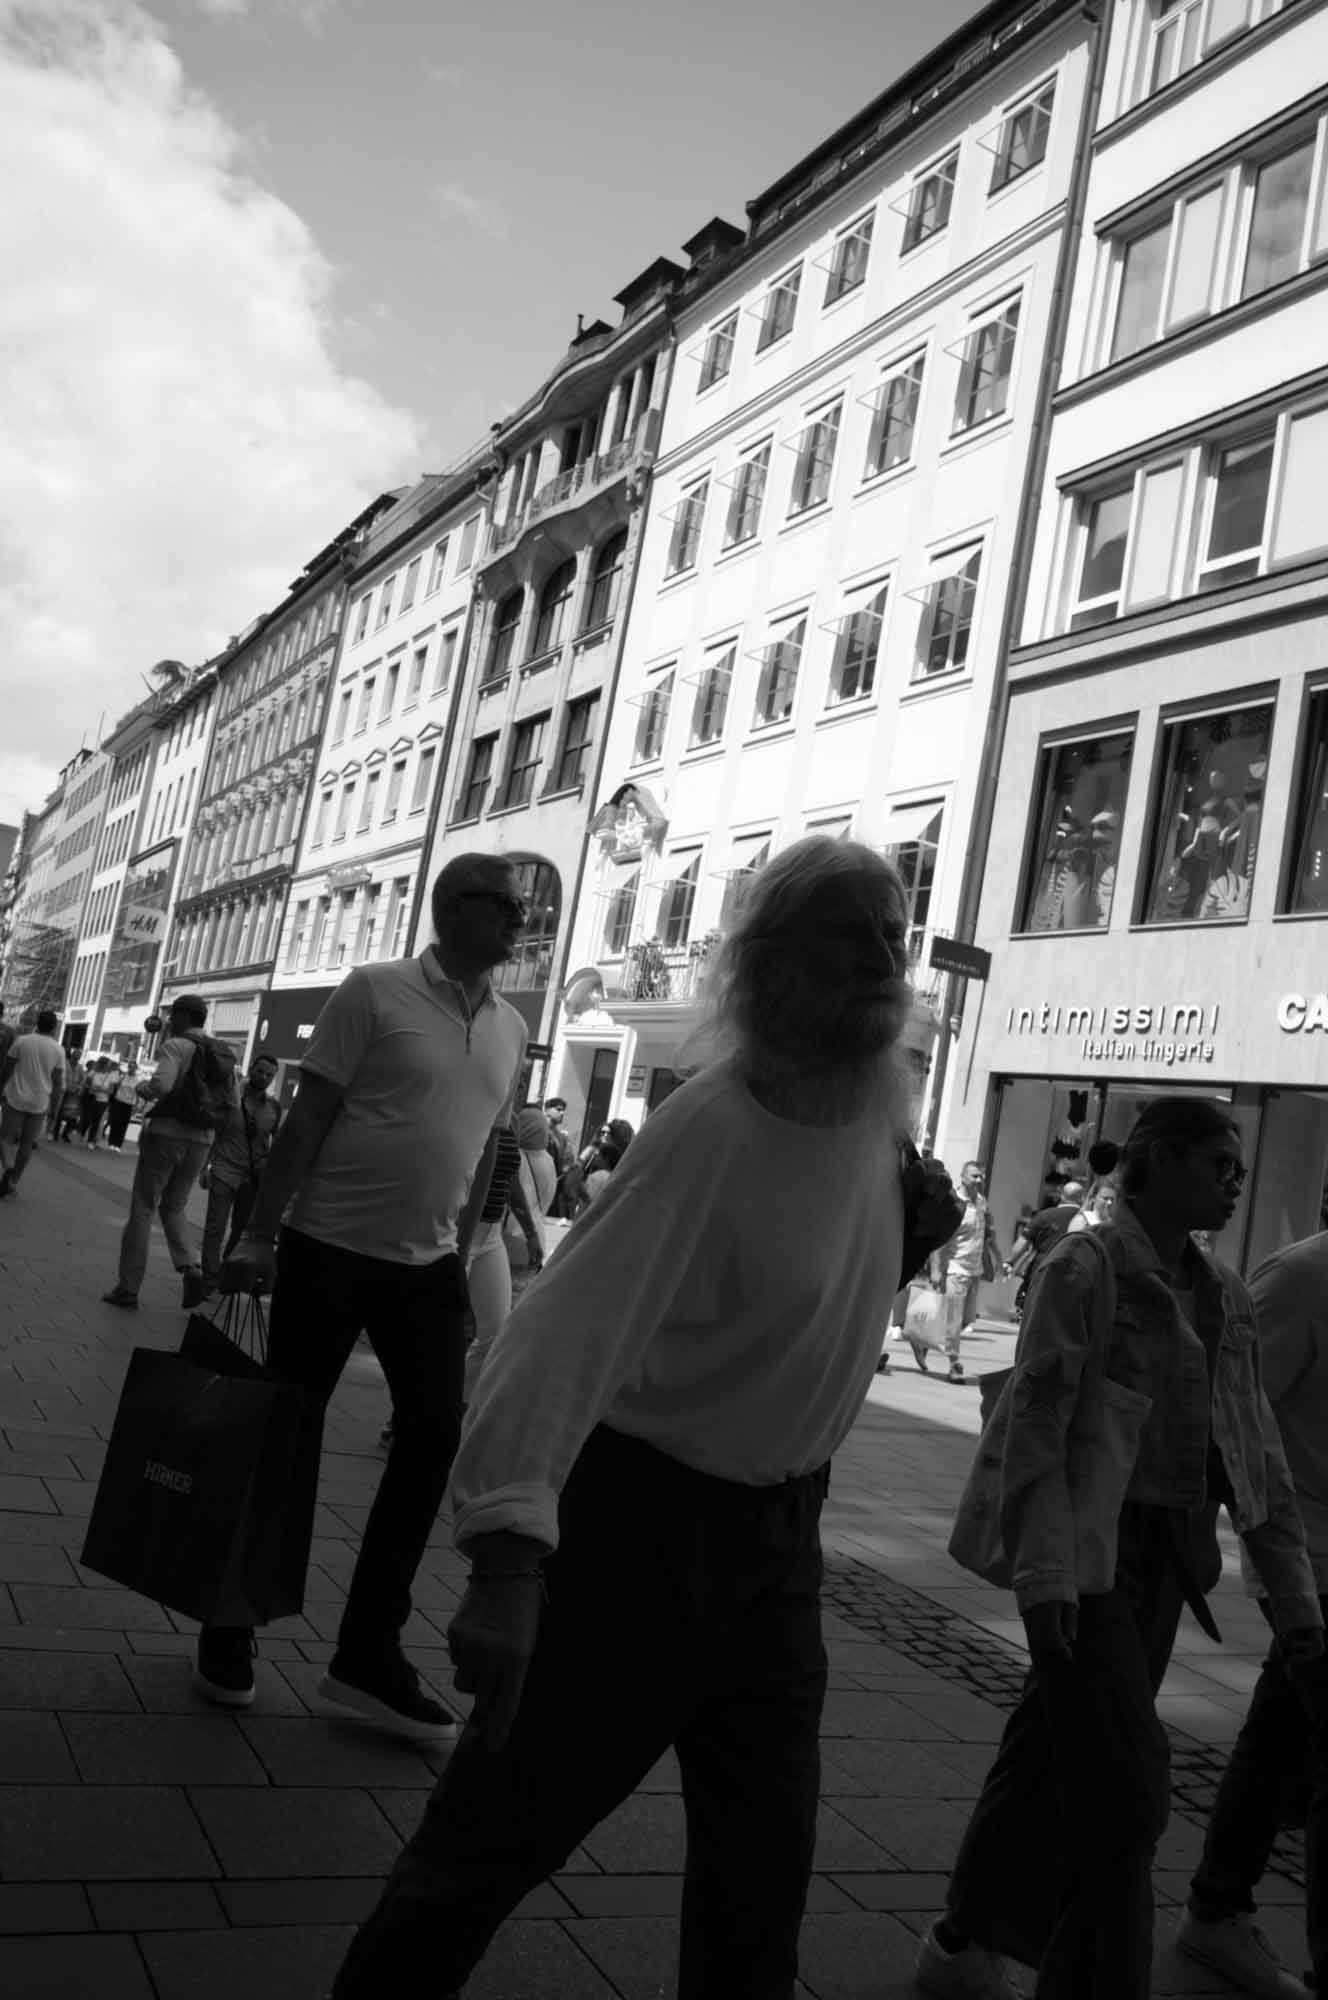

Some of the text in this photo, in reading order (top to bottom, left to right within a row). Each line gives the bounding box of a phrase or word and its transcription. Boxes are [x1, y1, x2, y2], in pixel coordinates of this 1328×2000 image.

[1006, 1001, 1219, 1035] intimissimi
[1082, 1039, 1214, 1066] Italian lingerie
